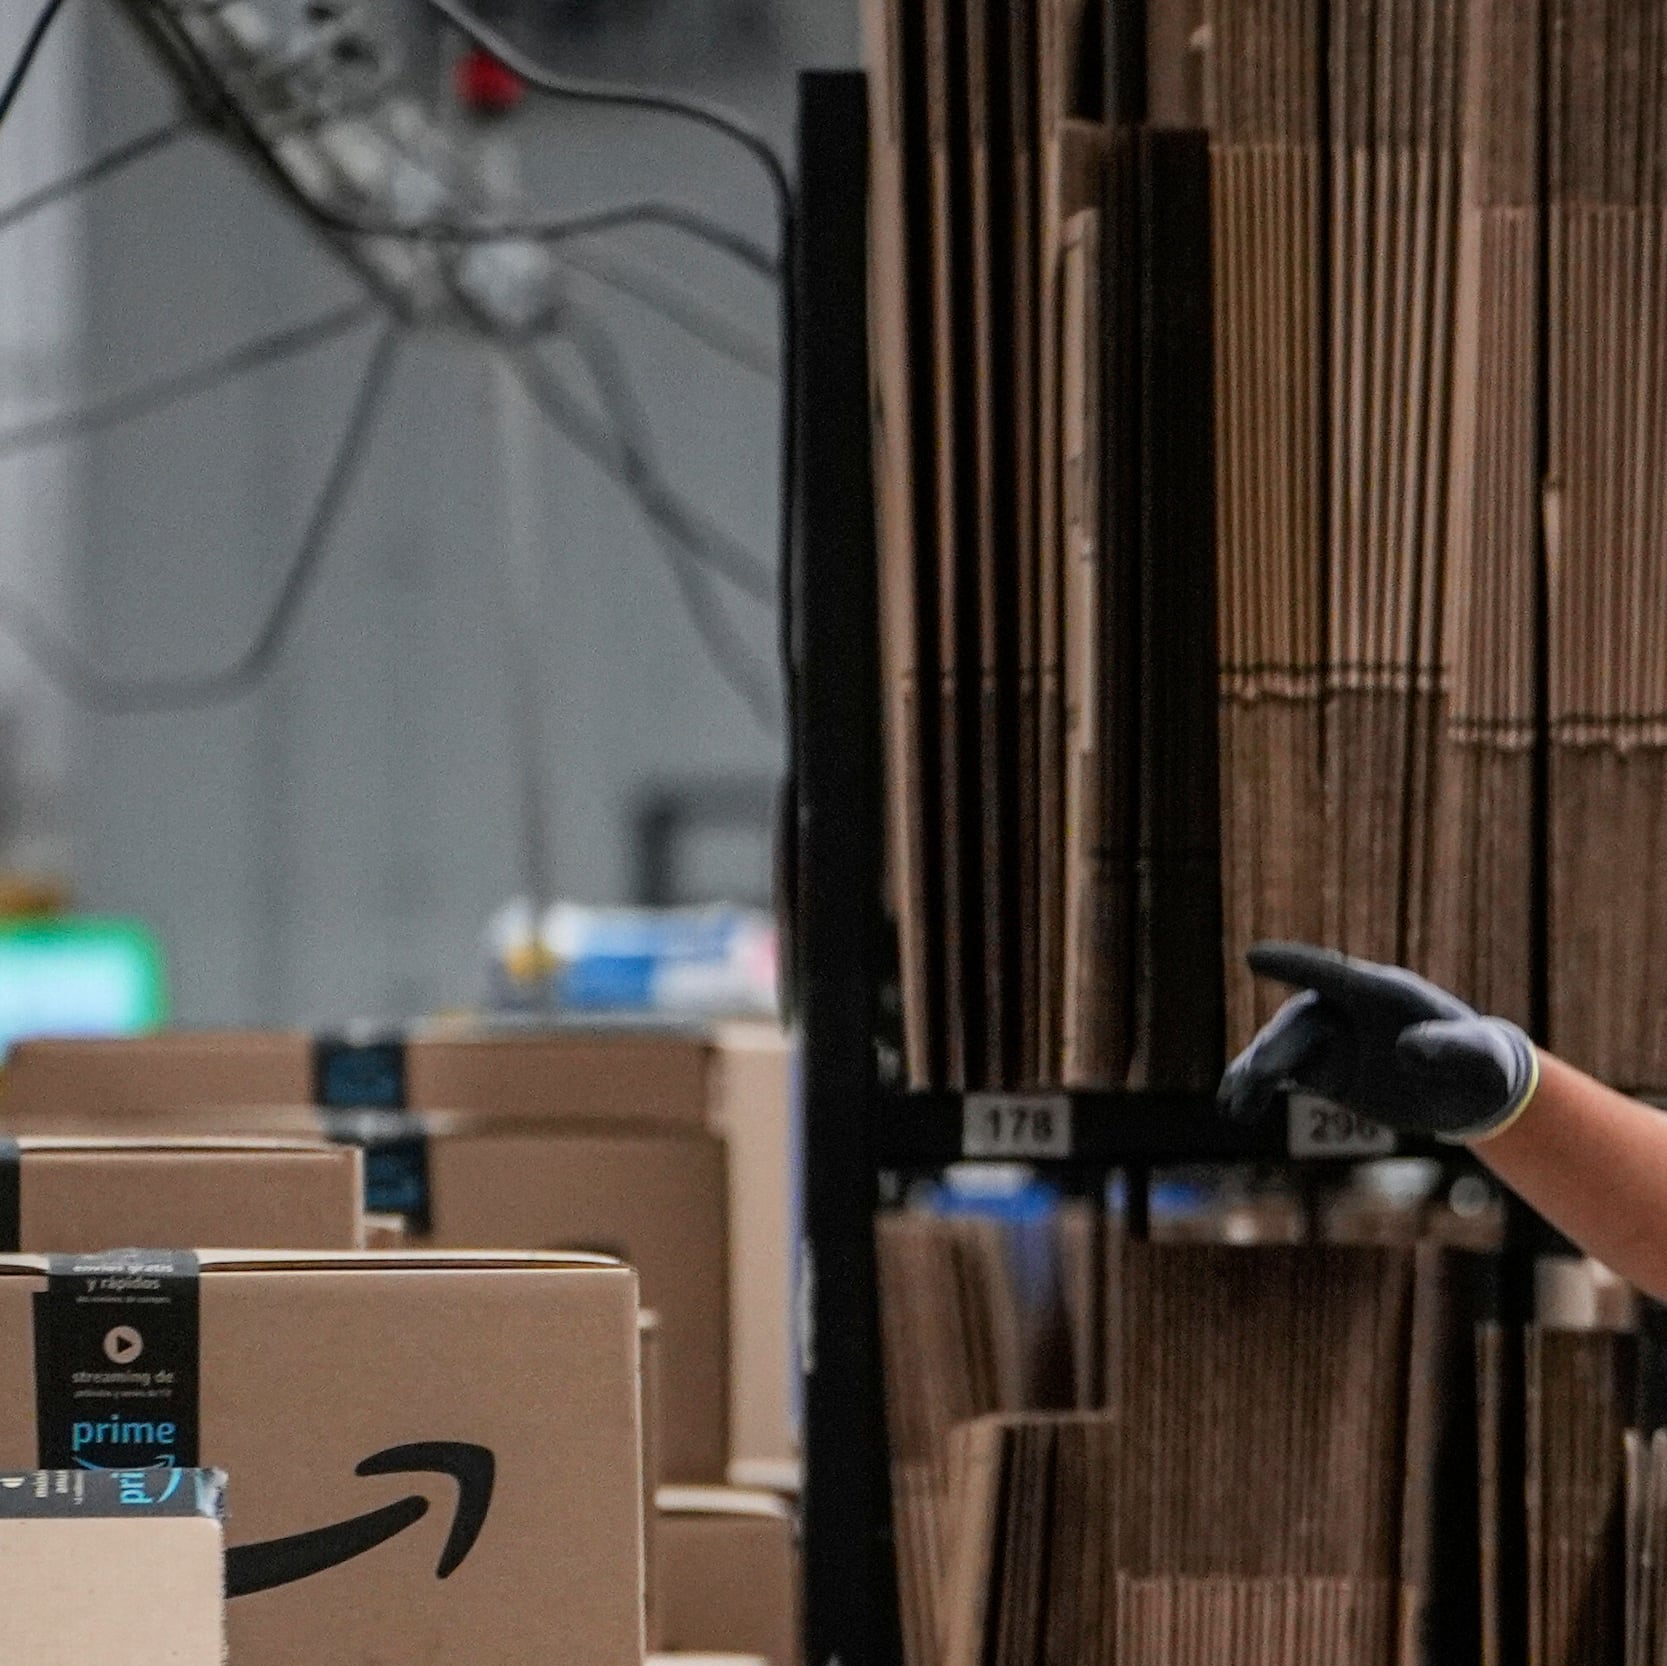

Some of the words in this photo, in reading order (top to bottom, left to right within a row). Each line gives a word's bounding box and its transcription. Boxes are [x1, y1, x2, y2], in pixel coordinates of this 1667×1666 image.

[986, 1107, 1053, 1142] 178
[72, 1413, 176, 1451] prime
[111, 1471, 153, 1505] pri
